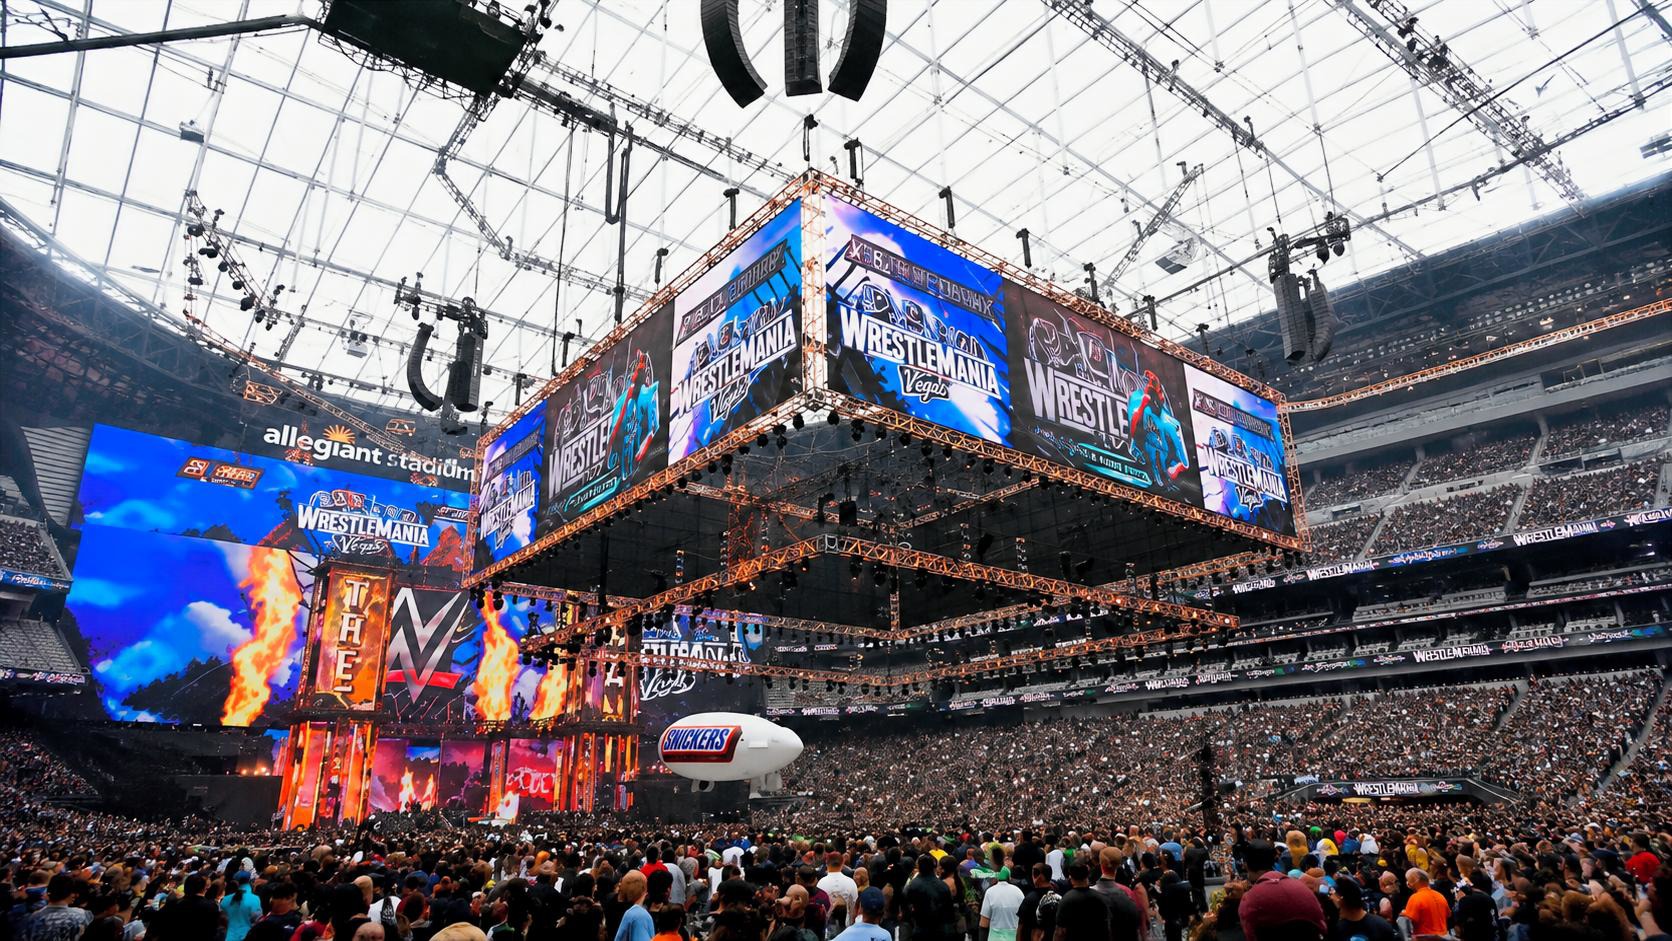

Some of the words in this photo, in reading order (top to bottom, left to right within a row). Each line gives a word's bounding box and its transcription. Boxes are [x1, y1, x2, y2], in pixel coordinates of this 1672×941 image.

[677, 308, 796, 418] WRESTLEMANIA
[839, 306, 1001, 399] WRESTLEMANIA
[903, 369, 947, 402] Vegas
[1024, 357, 1129, 438] WRESTLE
[264, 425, 382, 464] allegiant
[548, 421, 613, 500] WRESTLE
[298, 504, 429, 547] WRESTLEMANIA
[333, 579, 369, 691] THE
[664, 728, 730, 752] SNICKERS
